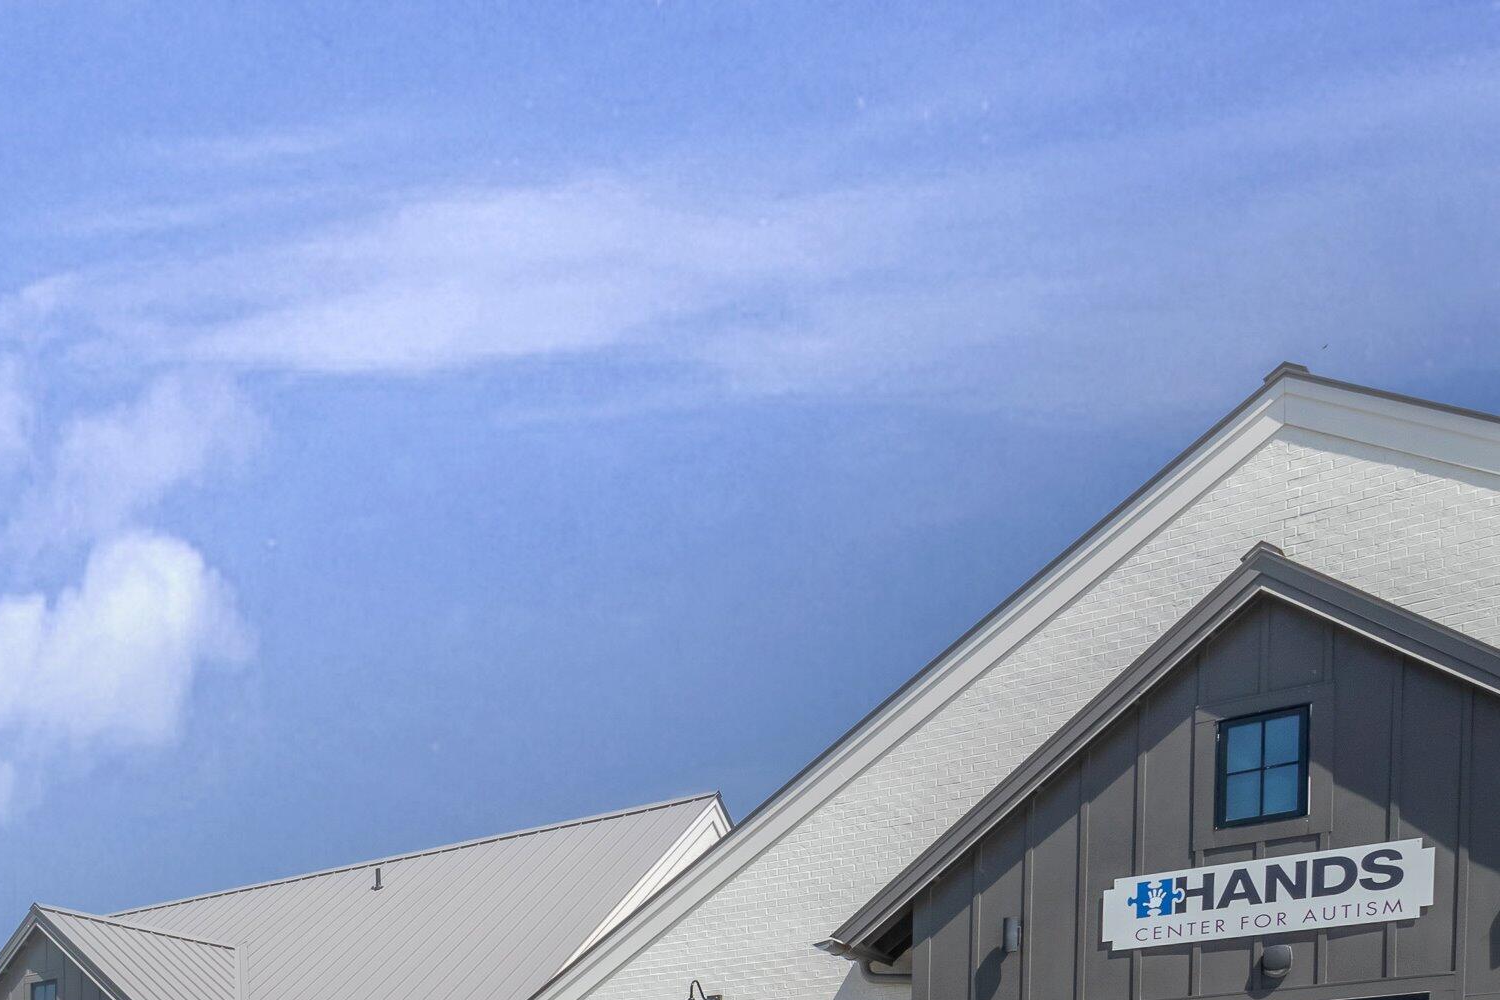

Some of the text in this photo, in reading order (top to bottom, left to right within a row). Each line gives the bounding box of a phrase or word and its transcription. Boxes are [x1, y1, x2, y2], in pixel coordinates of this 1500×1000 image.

[1175, 849, 1404, 914] HANDS
[1135, 899, 1403, 942] CENTER FOR AUTISM
